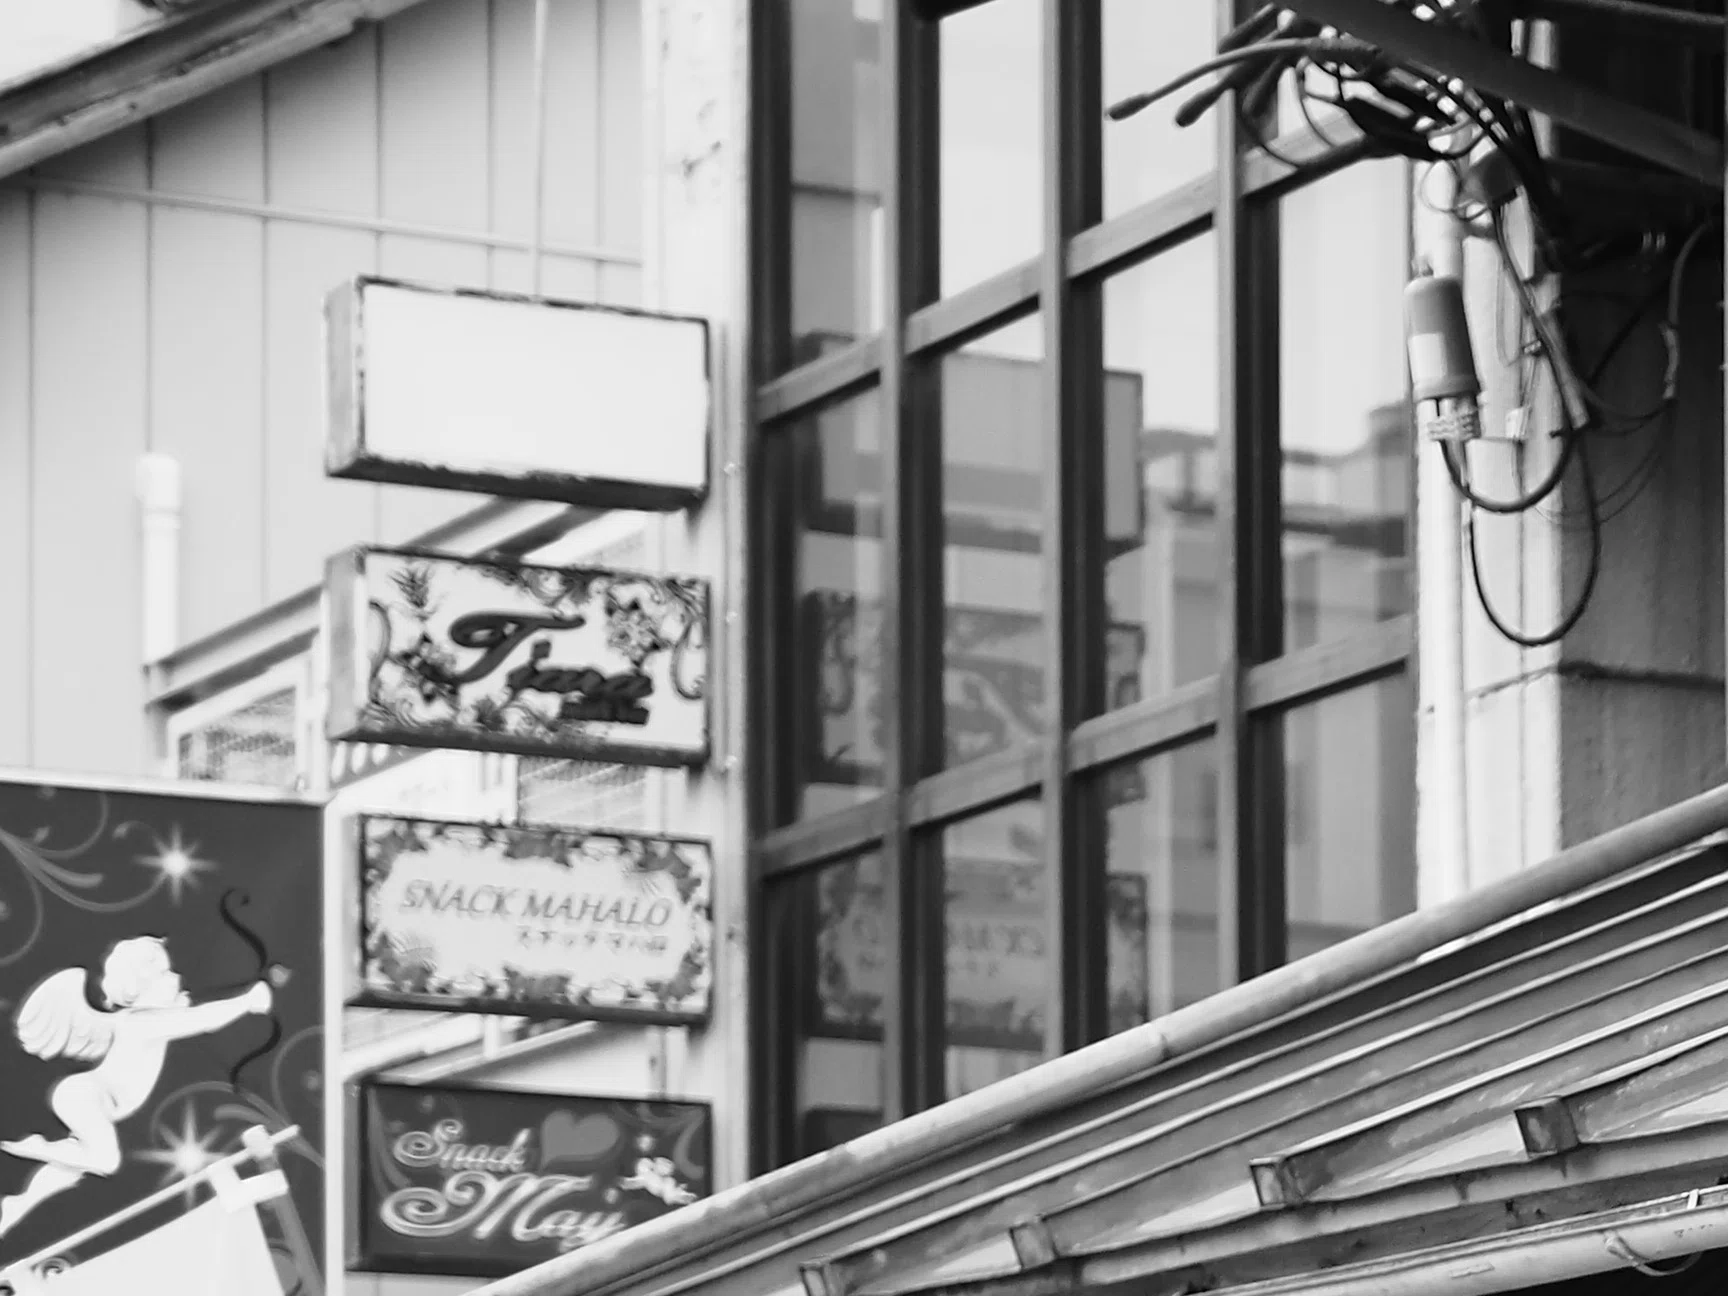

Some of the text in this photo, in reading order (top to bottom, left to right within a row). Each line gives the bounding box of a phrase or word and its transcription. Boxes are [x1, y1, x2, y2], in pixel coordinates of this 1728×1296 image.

[401, 878, 671, 928] SNACK MAHALO
[392, 1118, 532, 1173] Snack
